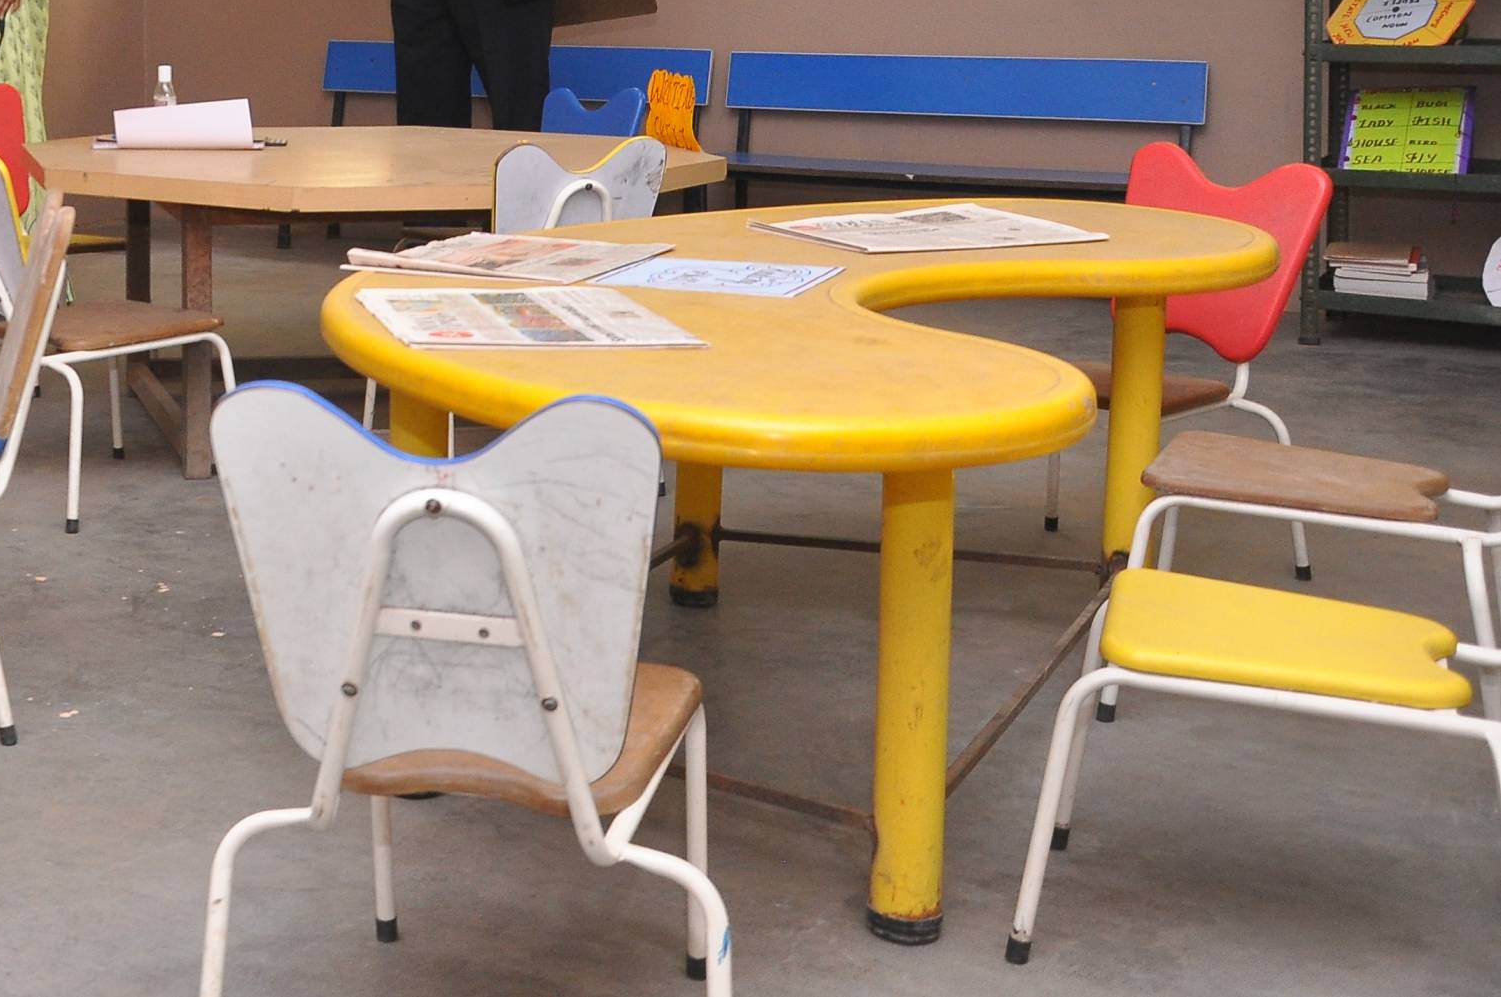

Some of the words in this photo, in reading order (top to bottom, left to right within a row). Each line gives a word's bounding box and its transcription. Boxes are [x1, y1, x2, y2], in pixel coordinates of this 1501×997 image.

[1365, 11, 1413, 23] COMMON
[1381, 21, 1409, 29] NOUN
[1359, 118, 1395, 128] LADY
[1411, 115, 1452, 126] FISH
[1354, 137, 1398, 148] HOUSE
[1354, 155, 1383, 164] SEA
[1405, 151, 1438, 164] FLY
